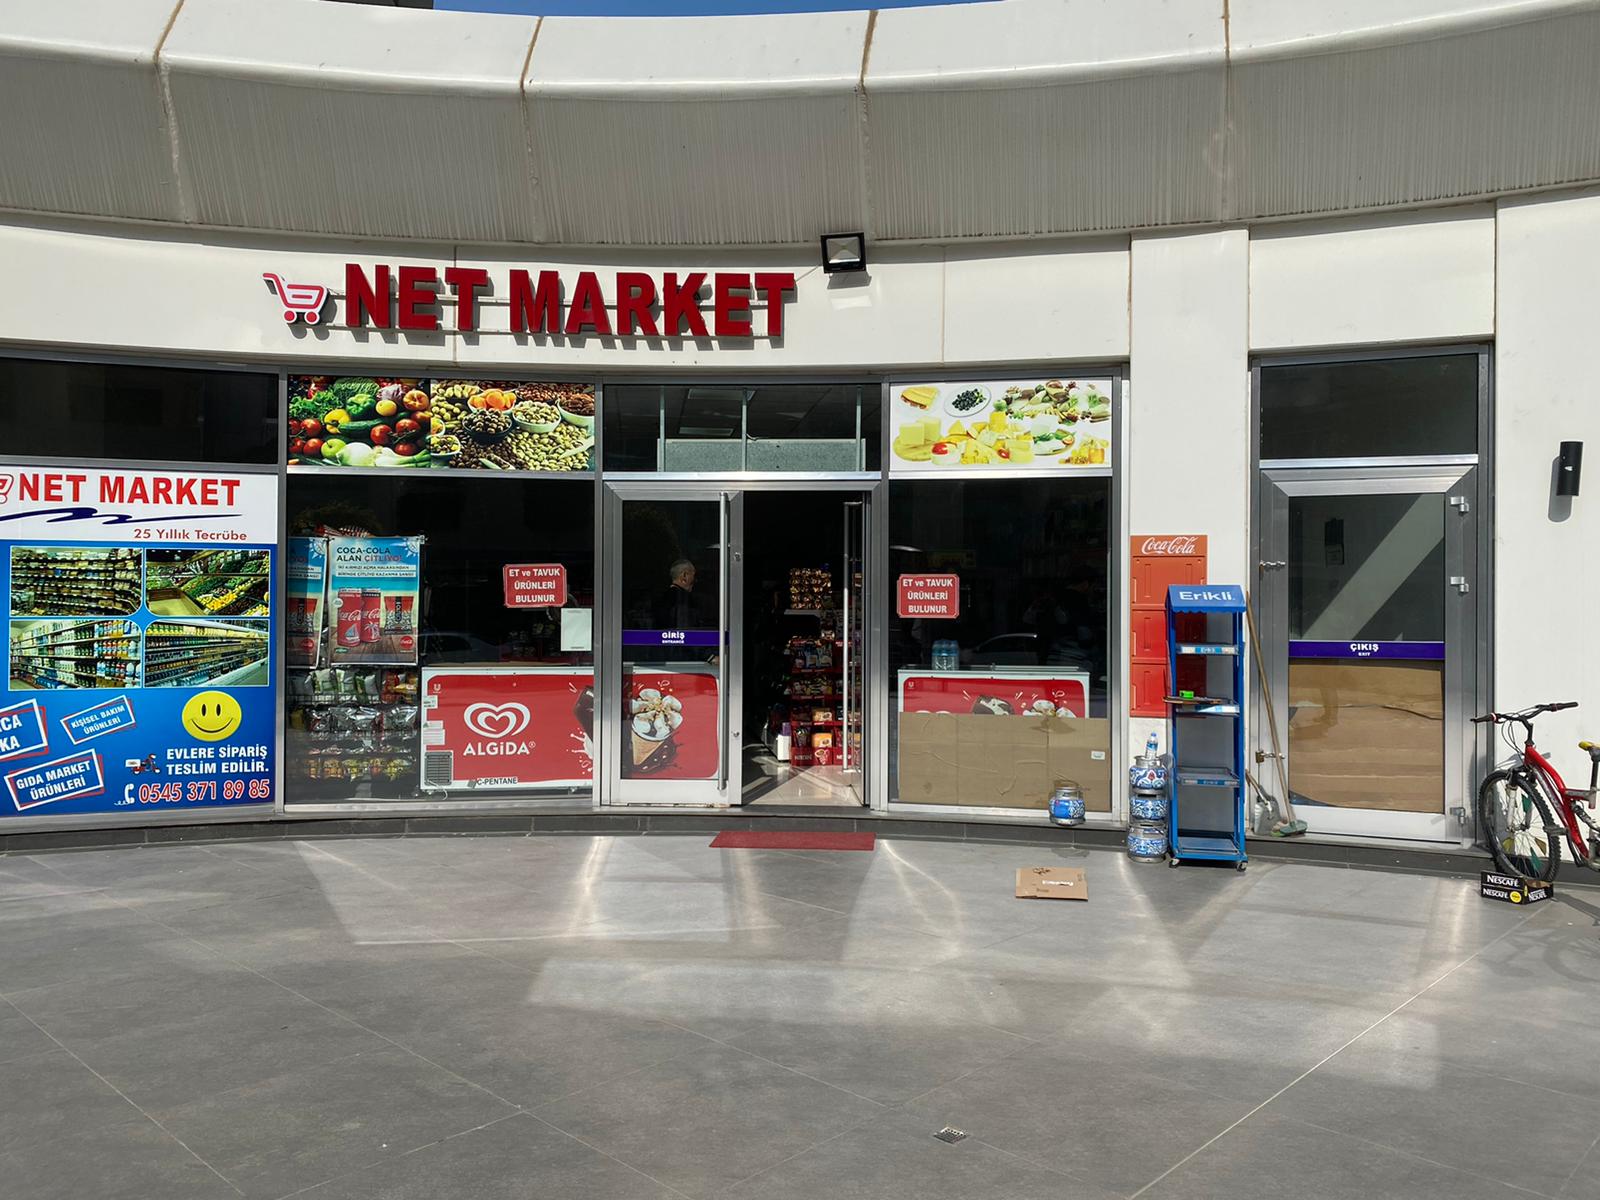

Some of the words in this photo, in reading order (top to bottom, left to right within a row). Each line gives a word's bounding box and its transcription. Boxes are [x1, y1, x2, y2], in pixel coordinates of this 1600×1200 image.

[345, 263, 488, 332] NET
[509, 268, 795, 337] MARKET
[19, 473, 87, 503] NET
[100, 475, 241, 506] MARKET
[133, 528, 151, 539] 25
[157, 529, 190, 540] Yıllık
[195, 530, 247, 541] Tecrübe
[1141, 536, 1200, 555] Coca-Cola
[336, 554, 362, 562] ALAN
[509, 569, 520, 577] ET
[532, 568, 561, 577] TAVUK
[514, 580, 556, 590] ÜRÜNLERİ
[902, 578, 913, 587] ET
[925, 578, 953, 587] TAVUK
[515, 594, 555, 603] BULUNUR
[907, 590, 948, 600] ÜRÜNLERİ
[1178, 591, 1232, 601] Erikli
[908, 604, 948, 613] BULUNUR
[661, 630, 685, 640] GİRİŞ
[1350, 643, 1379, 652] ÇIKIŞ
[0, 714, 23, 732] CA
[70, 714, 100, 729] KİŞİSEL
[100, 705, 125, 719] BAKIM
[83, 716, 121, 735] ÜRÜNLERİ
[166, 747, 215, 760] EVLERE
[218, 744, 268, 760] SİPARİŞ
[166, 761, 217, 775] TESLİM
[221, 759, 269, 774] EDİLİR.
[16, 774, 44, 790] GIDA
[45, 760, 91, 782] MARKET
[30, 775, 87, 800] ÜRÜNLERİ
[139, 782, 182, 804] 0545
[187, 781, 217, 802] 371
[223, 779, 245, 801] 89
[249, 778, 270, 799] 85
